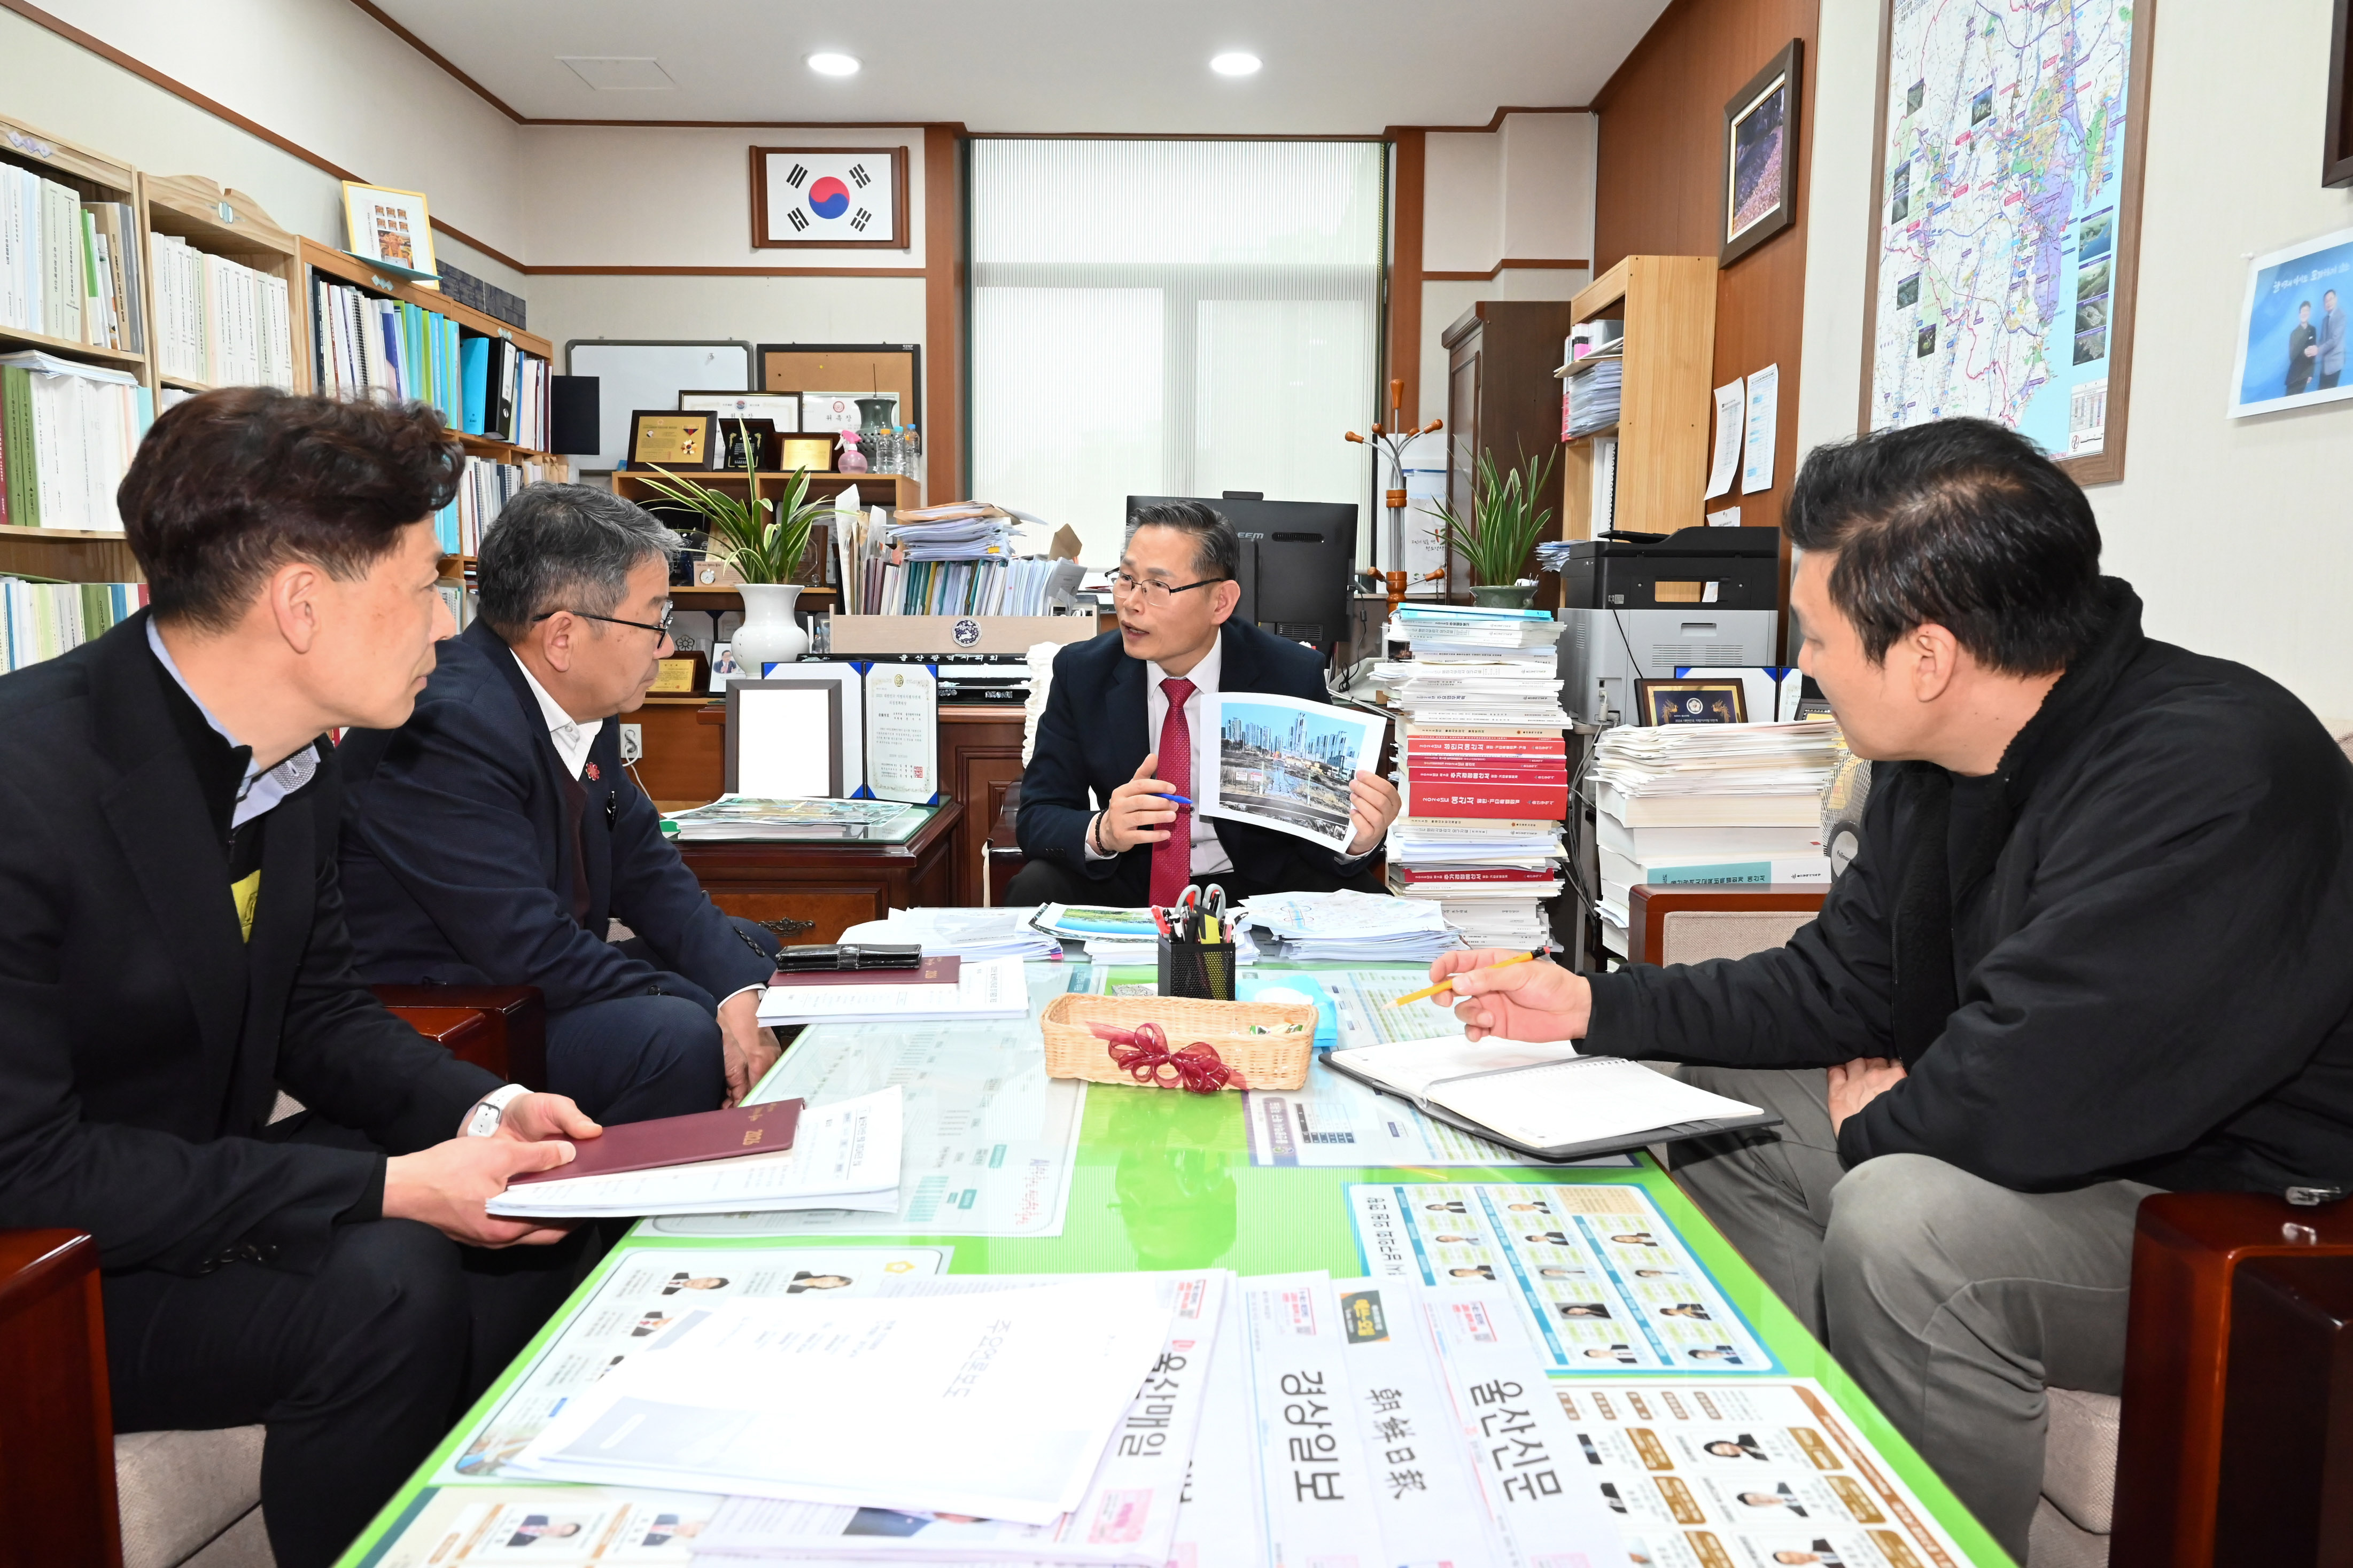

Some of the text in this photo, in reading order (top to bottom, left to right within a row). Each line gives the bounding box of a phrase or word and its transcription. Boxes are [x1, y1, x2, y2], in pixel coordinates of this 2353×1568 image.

[1451, 796, 1474, 805] 예산서
[1747, 874, 1765, 883] 예산서
[1366, 1197, 1388, 1211] 현황
[1371, 1213, 1390, 1228] 의원
[1375, 1231, 1402, 1261] 남구의회
[942, 1319, 1012, 1399] 주요언론보도
[1118, 1352, 1187, 1457] 울산매일
[1281, 1370, 1345, 1502] 경상일보
[1364, 1388, 1427, 1500] 朝鮮日報
[1470, 1379, 1563, 1502] 울산신문
